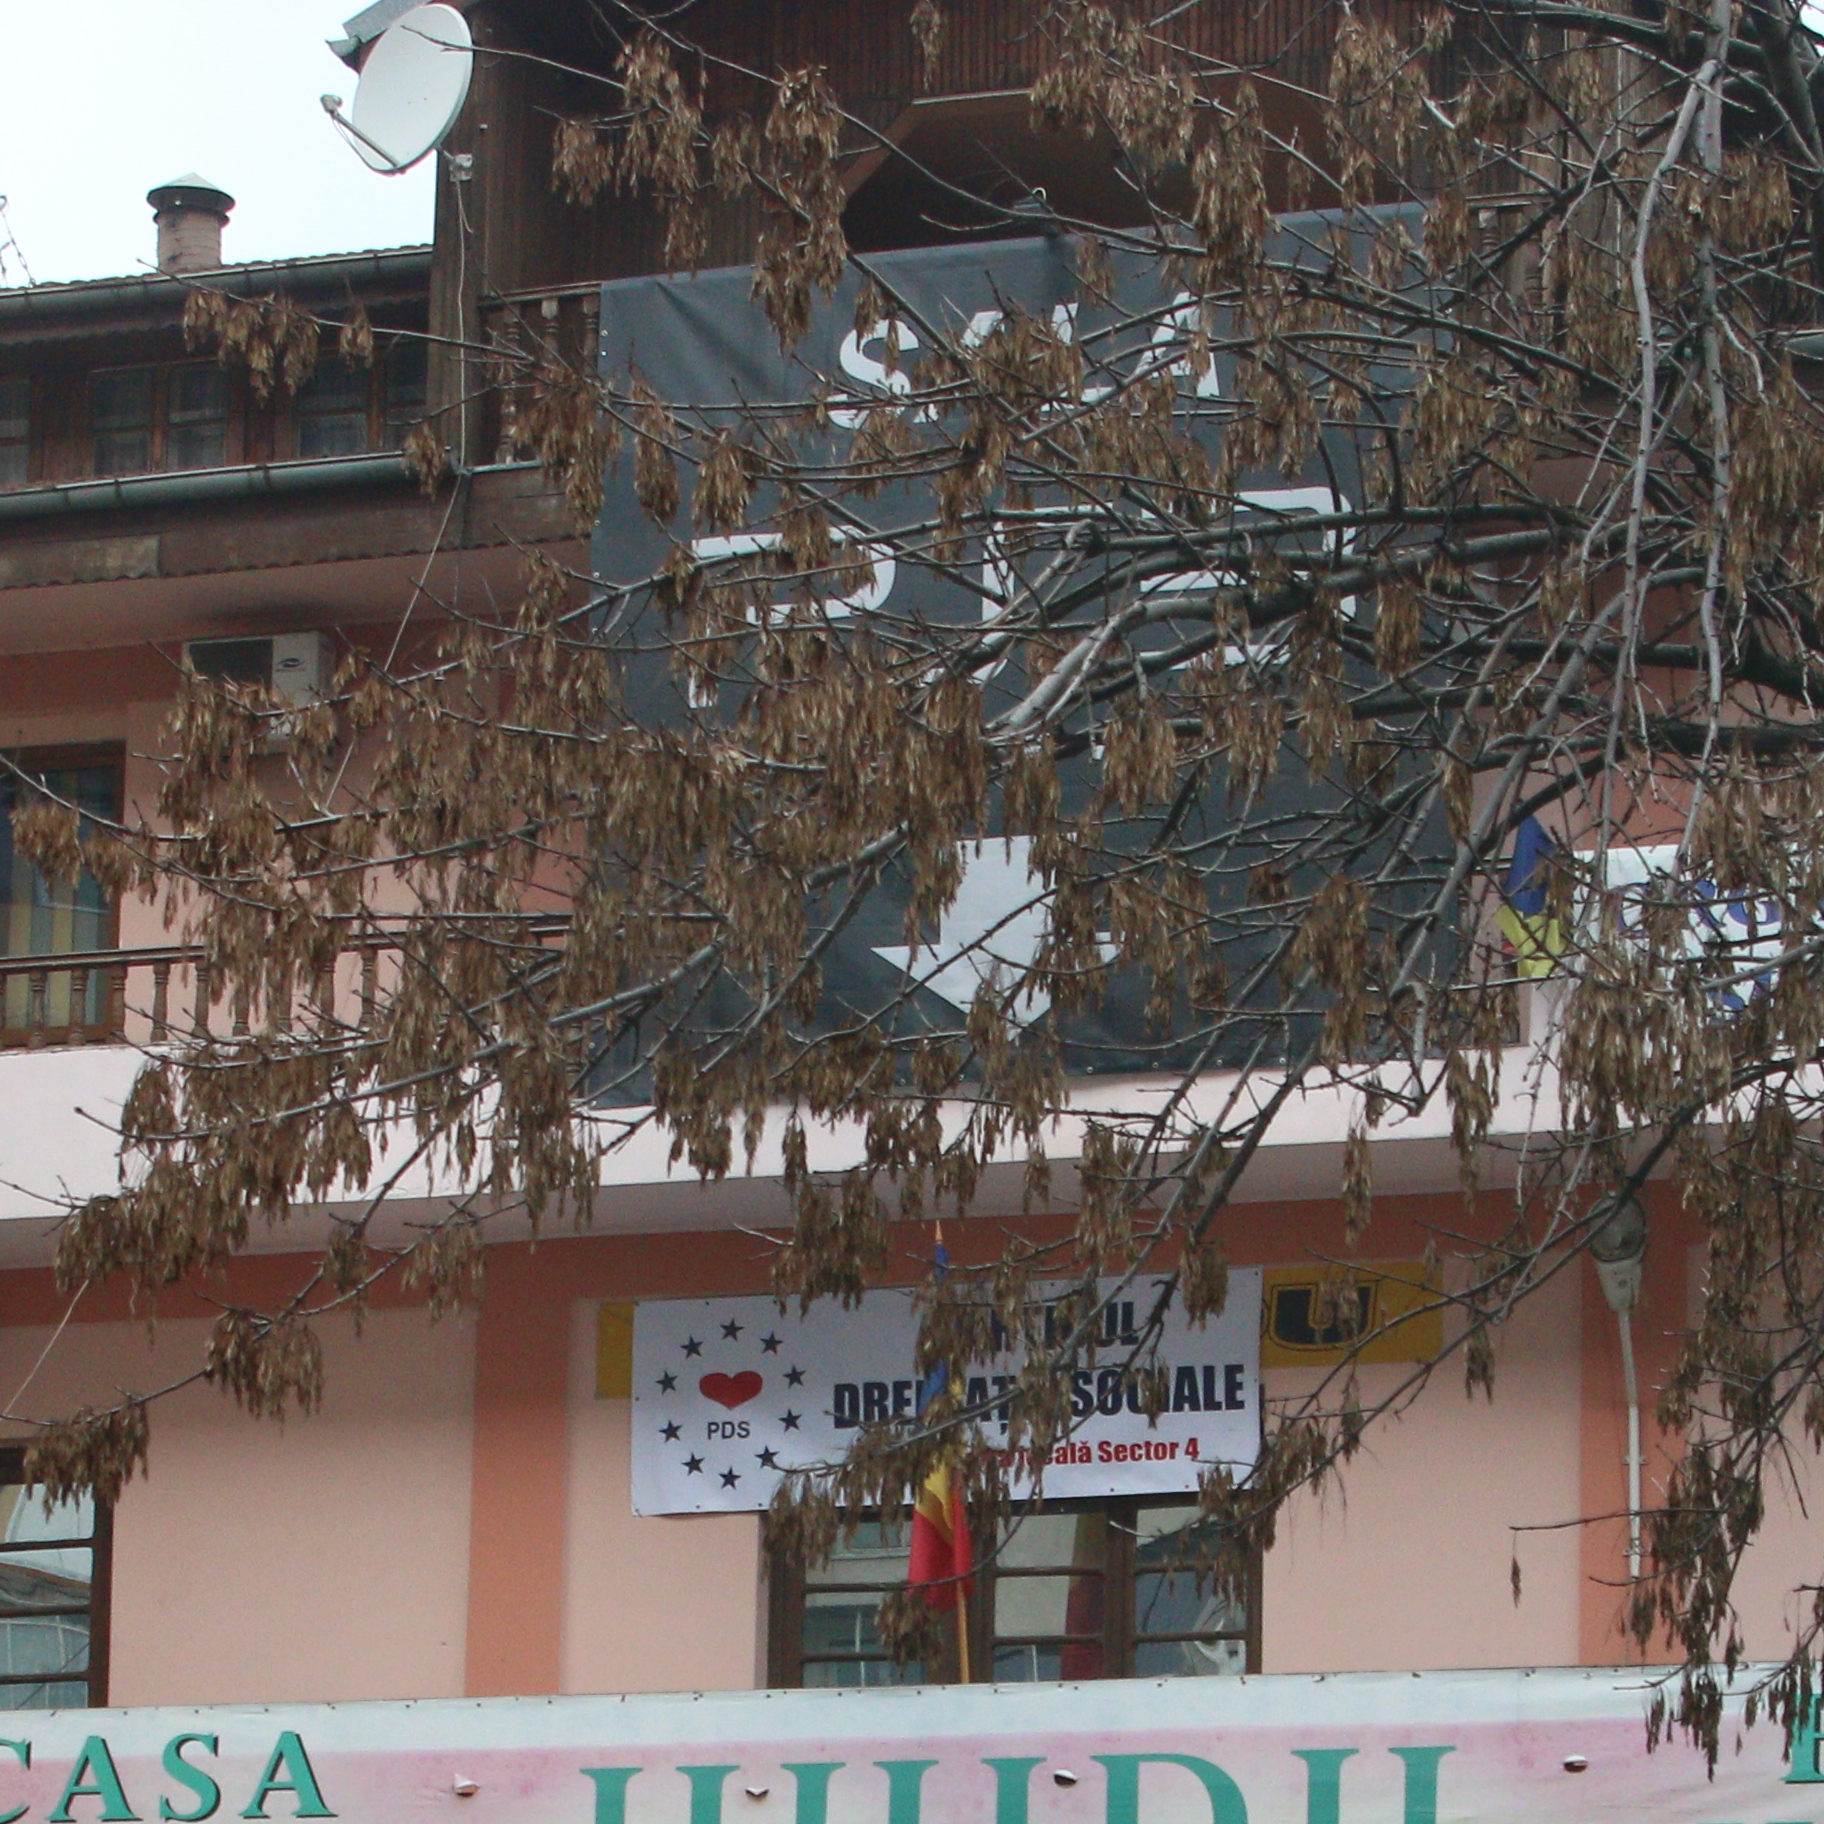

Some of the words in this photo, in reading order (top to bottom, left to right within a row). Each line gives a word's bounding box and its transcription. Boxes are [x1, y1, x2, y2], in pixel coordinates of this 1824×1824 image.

[706, 1418, 751, 1442] PDS
[1098, 1440, 1179, 1463] Sector
[1185, 1437, 1200, 1460] 4
